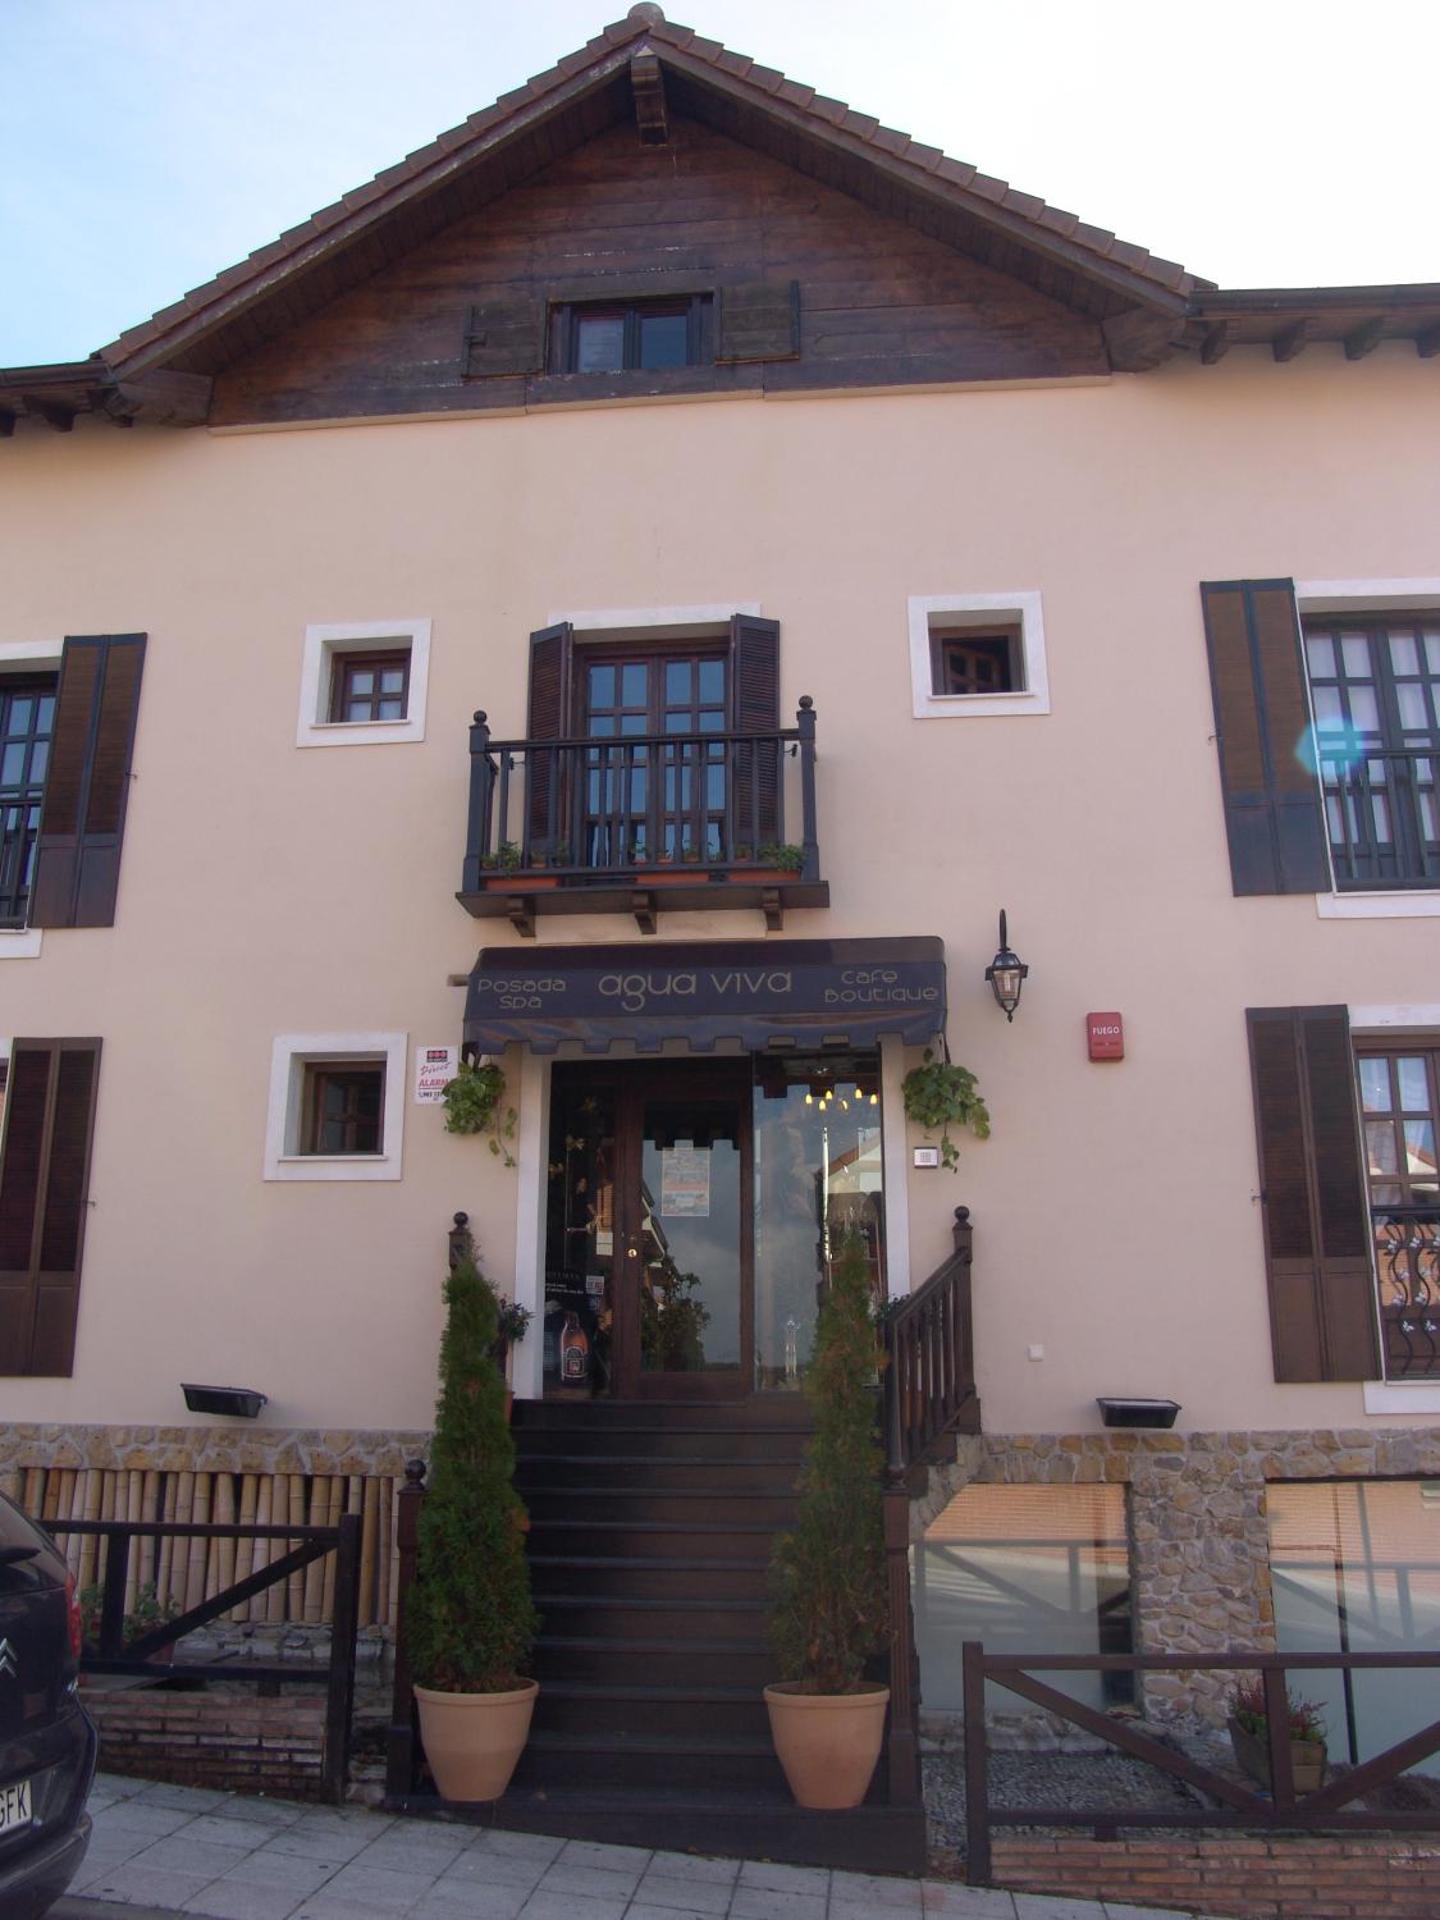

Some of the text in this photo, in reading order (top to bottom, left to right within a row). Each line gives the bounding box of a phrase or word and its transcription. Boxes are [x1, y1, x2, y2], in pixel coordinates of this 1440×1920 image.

[598, 971, 792, 1012] agua viva
[1092, 1026, 1120, 1036] FUEGO
